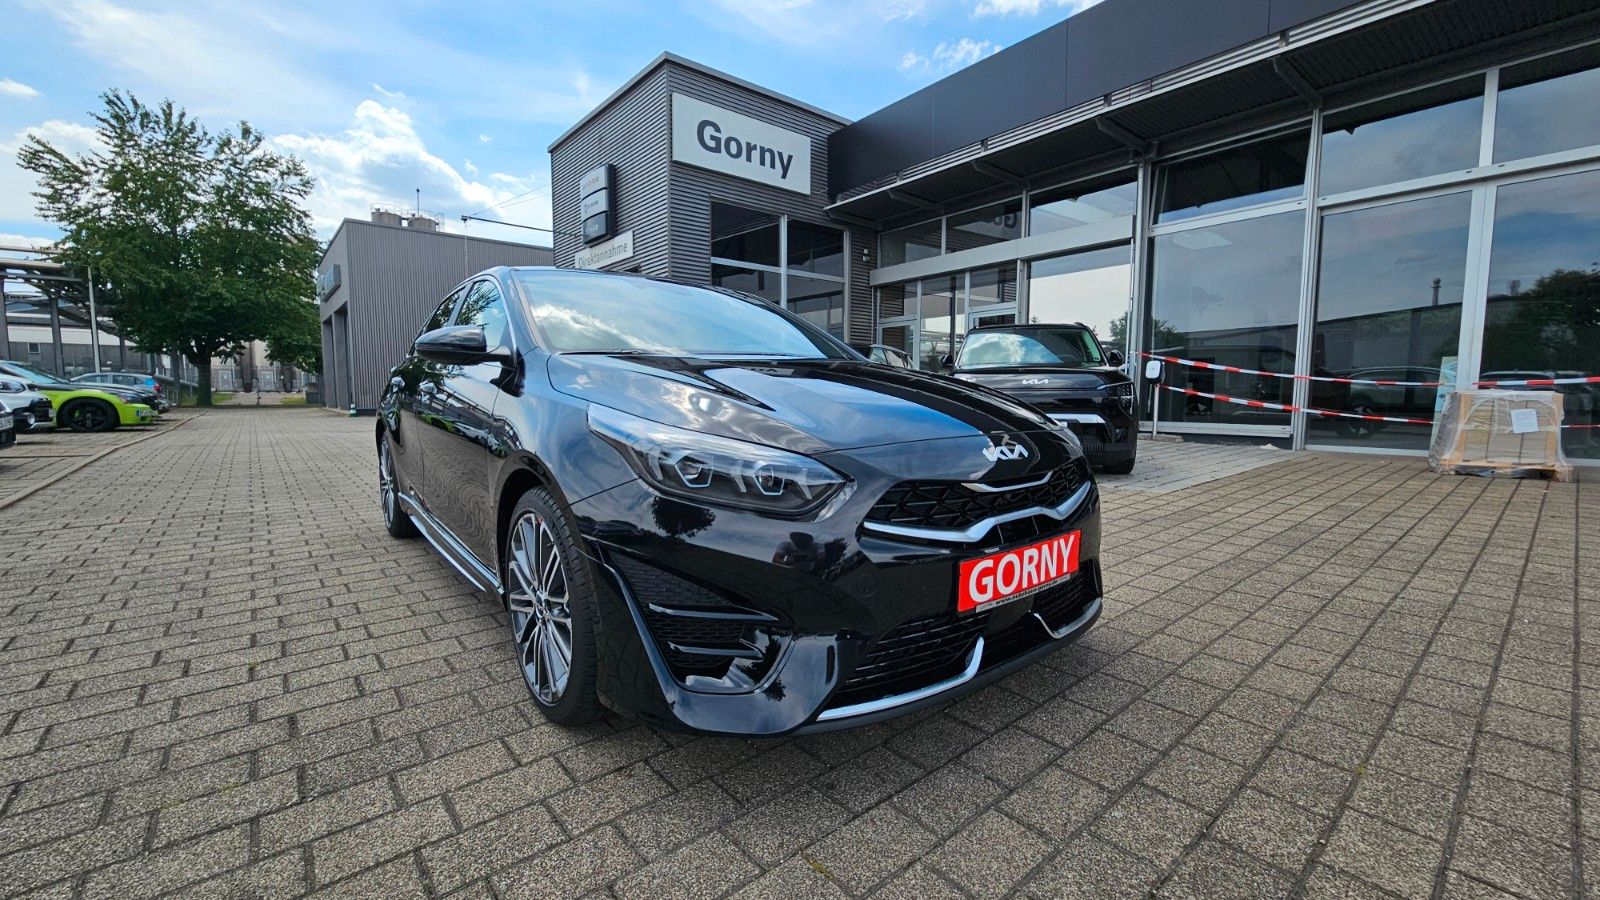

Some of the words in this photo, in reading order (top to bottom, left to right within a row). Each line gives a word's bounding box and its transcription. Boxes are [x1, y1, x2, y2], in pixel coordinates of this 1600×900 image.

[696, 119, 794, 180] Gorny
[578, 242, 628, 269] Direktannahme
[969, 534, 1075, 603] GORNY
